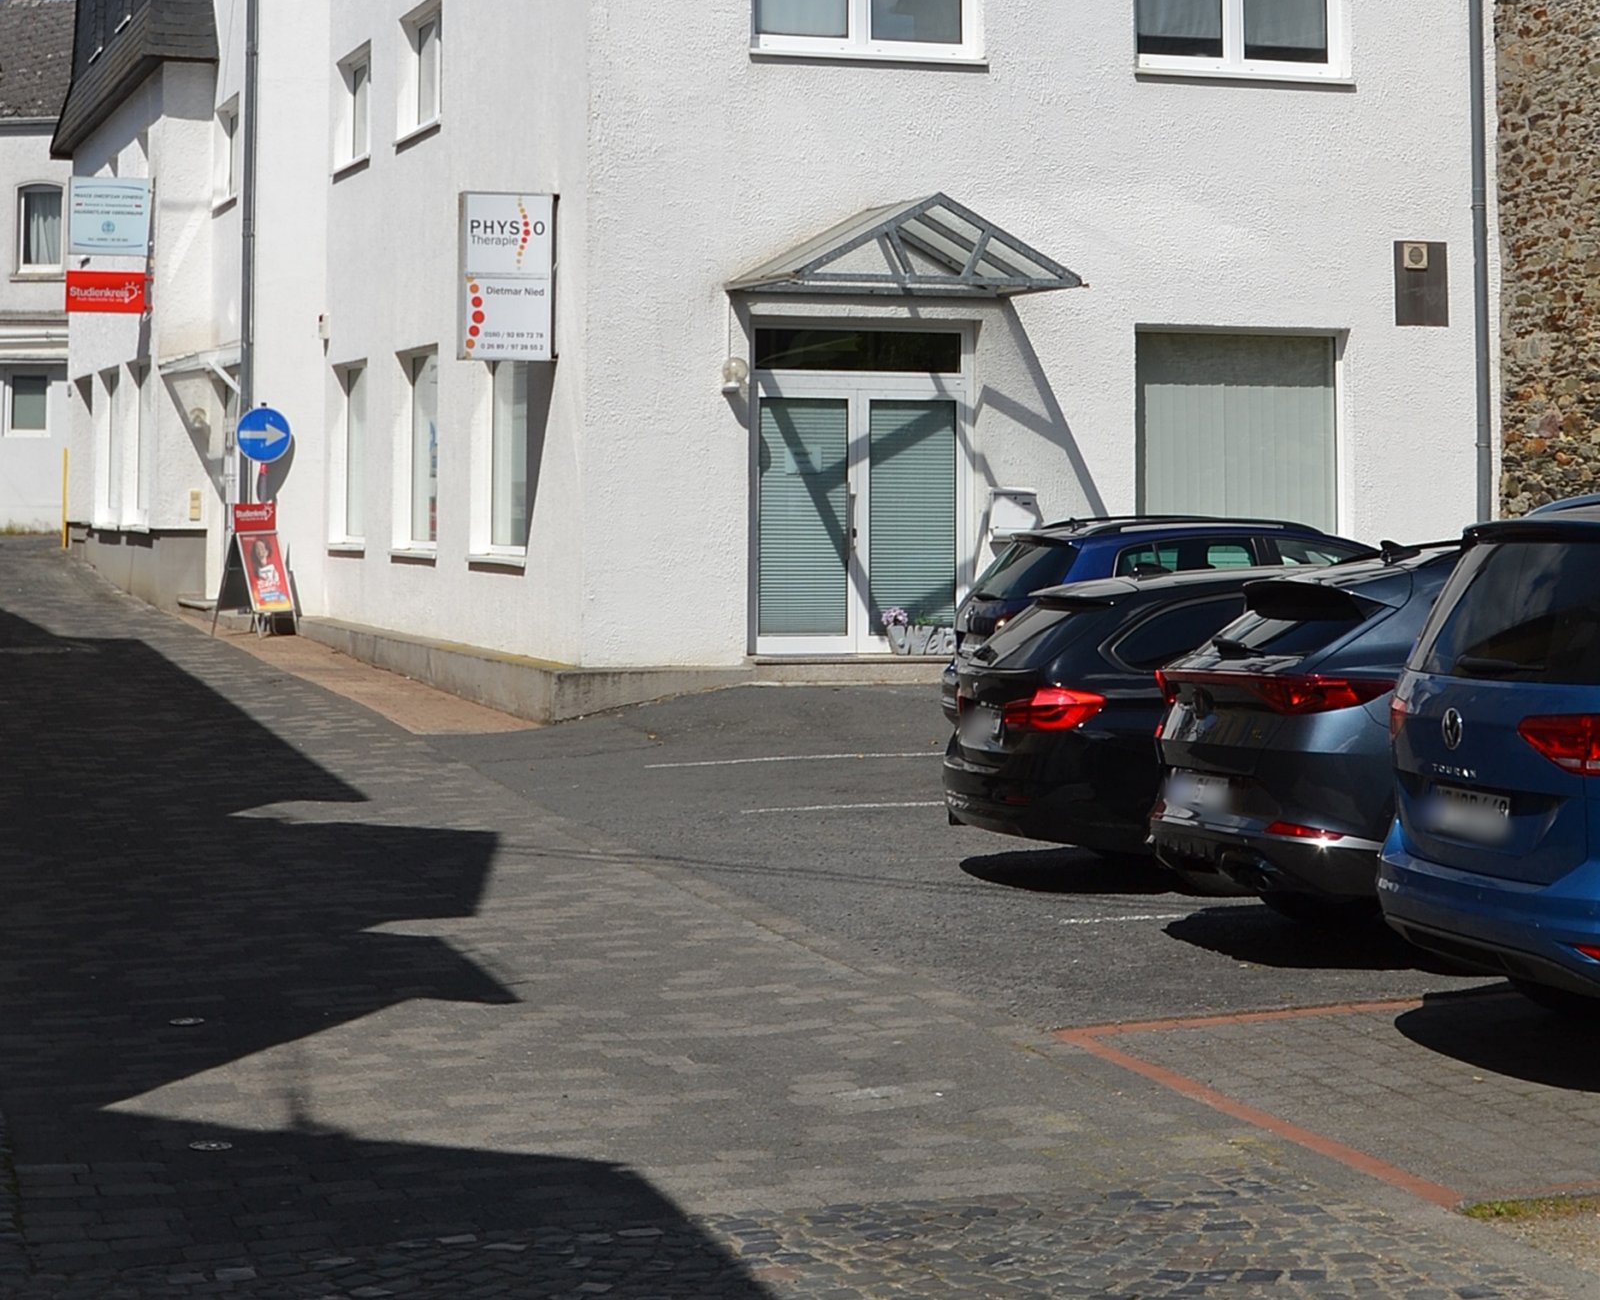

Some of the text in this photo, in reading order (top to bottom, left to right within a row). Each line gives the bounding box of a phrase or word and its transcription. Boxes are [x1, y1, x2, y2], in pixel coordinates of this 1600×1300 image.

[471, 235, 519, 247] Therapie
[70, 286, 129, 298] Studienkreis
[486, 286, 545, 296] Dietmar Nied
